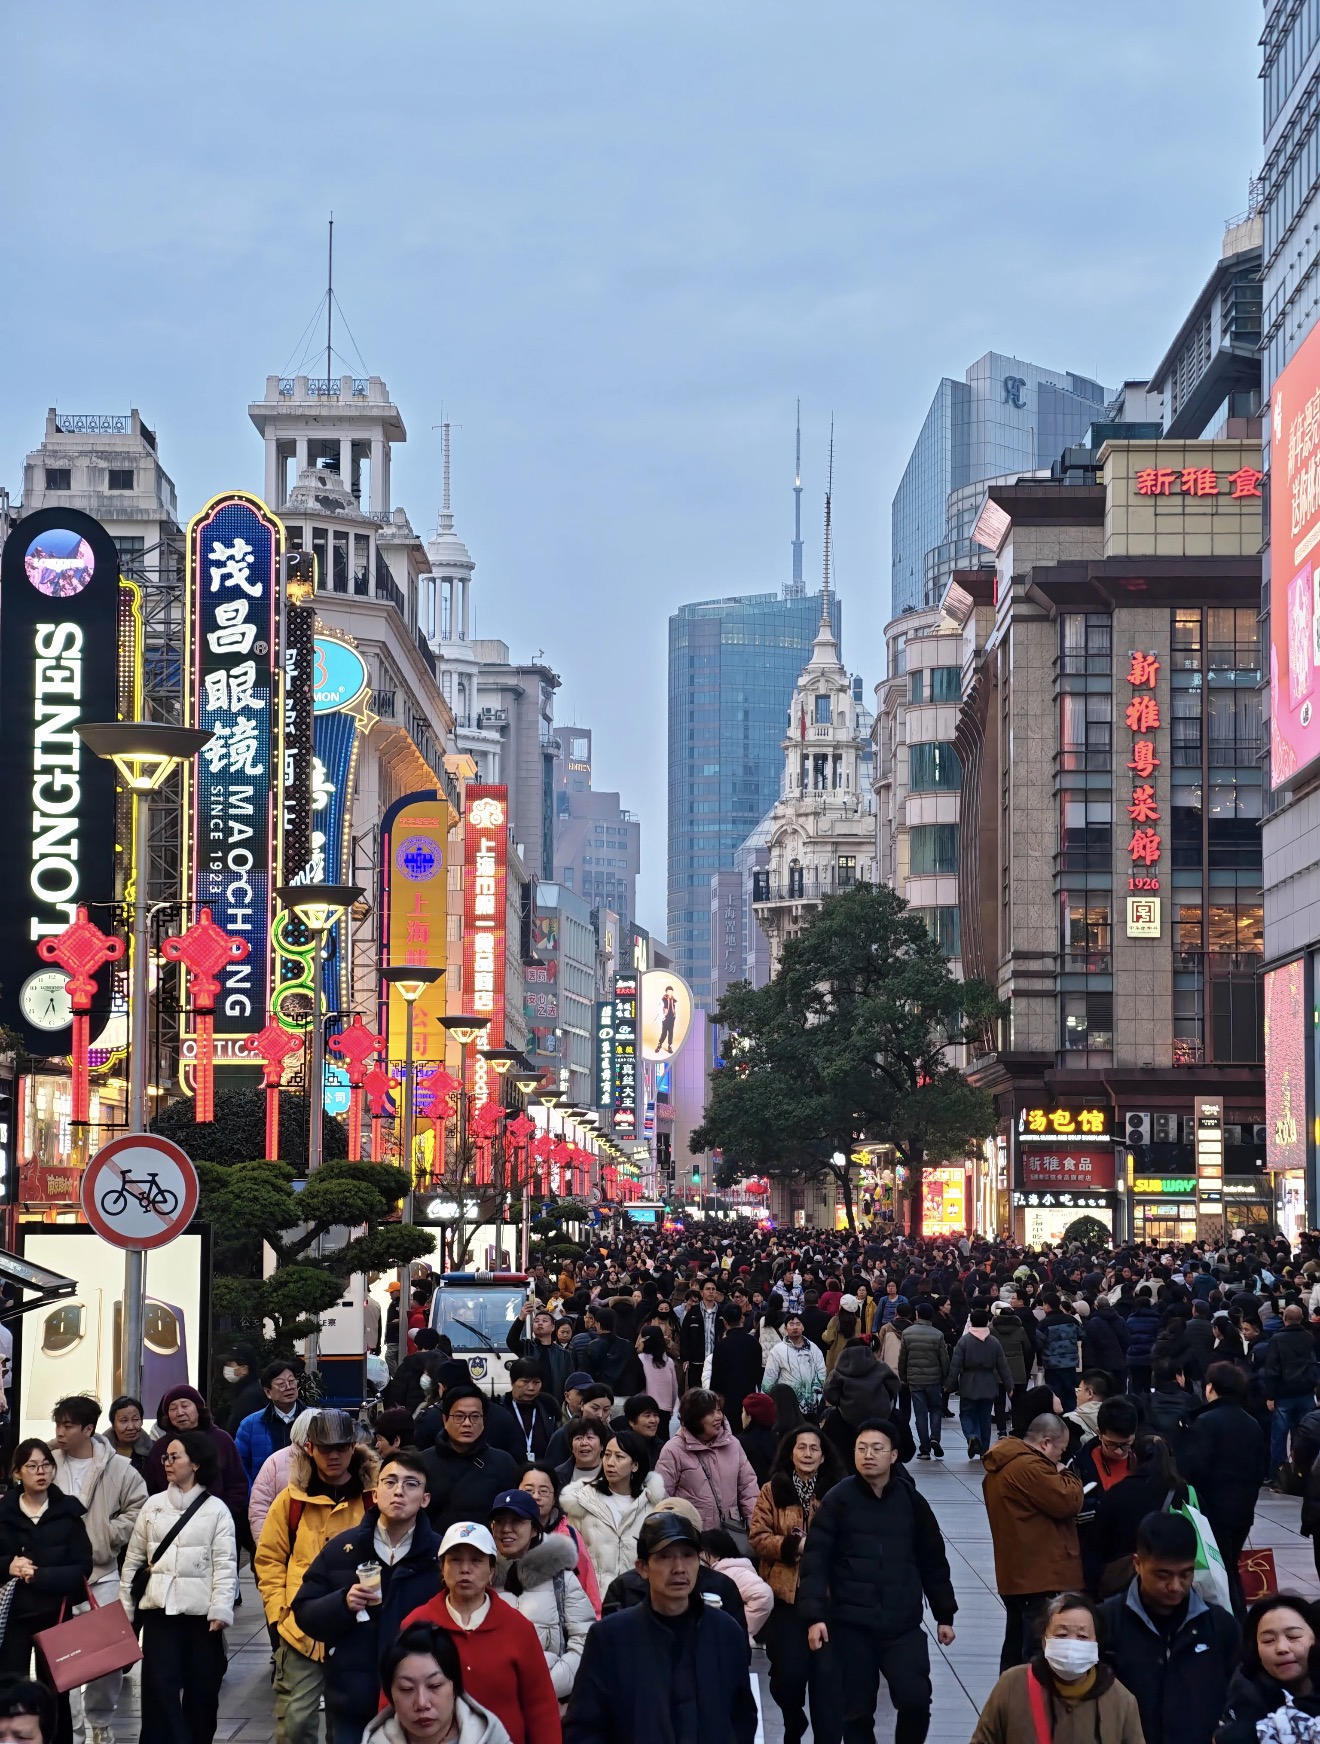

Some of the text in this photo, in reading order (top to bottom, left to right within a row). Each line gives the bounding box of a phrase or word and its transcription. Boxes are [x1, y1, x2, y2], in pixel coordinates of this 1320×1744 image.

[1136, 466, 1263, 498] 新雅食
[30, 621, 84, 941] LONGINES
[209, 786, 224, 894] SINCE 1923
[1128, 878, 1160, 890] 1926
[225, 786, 254, 1017] MAOCHNG
[724, 893, 737, 974] 上海置地广场
[528, 970, 547, 982] 医药
[621, 1064, 635, 1107] 真丝大王
[1028, 1109, 1105, 1132] 汤包馆
[1029, 1156, 1092, 1171] 新雅食品
[1133, 1179, 1197, 1192] SUBWAY
